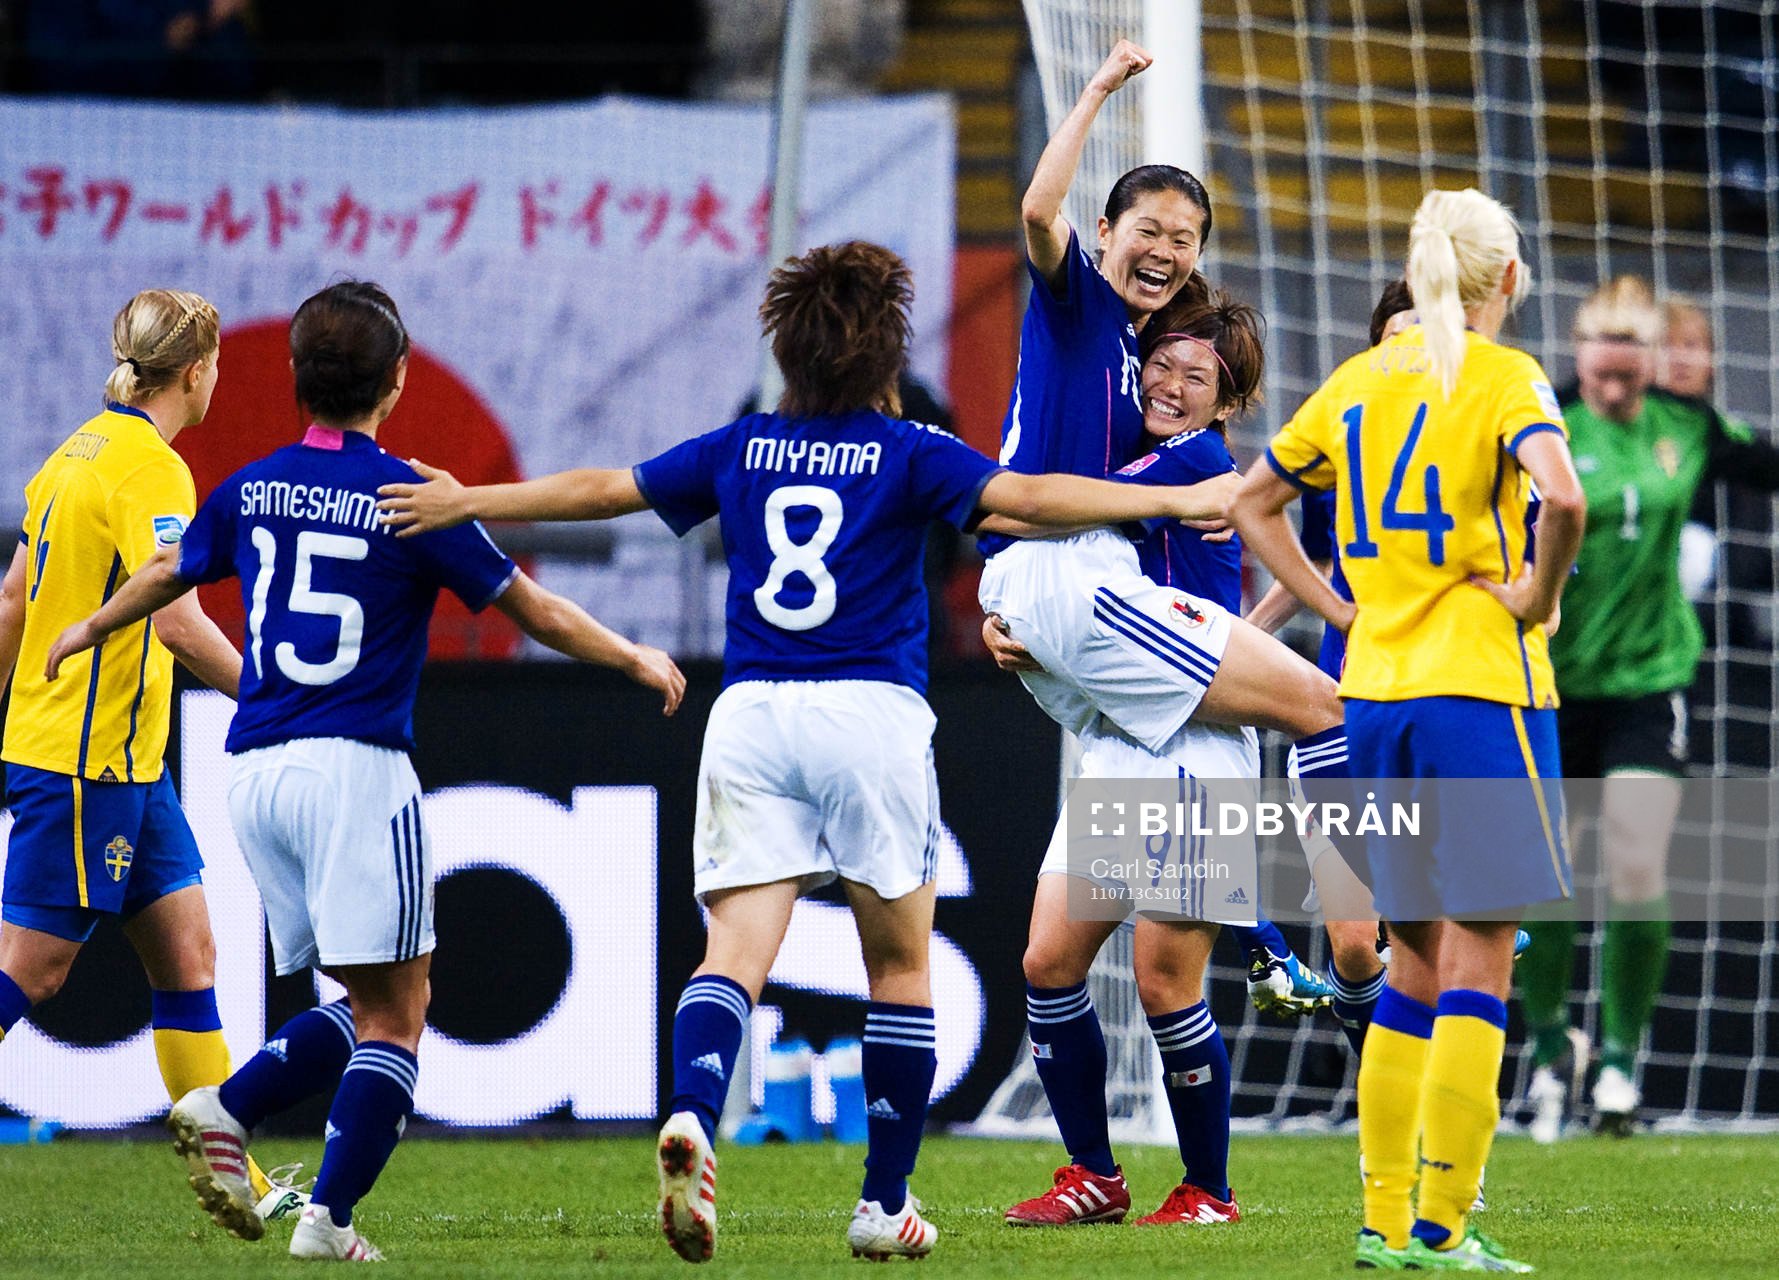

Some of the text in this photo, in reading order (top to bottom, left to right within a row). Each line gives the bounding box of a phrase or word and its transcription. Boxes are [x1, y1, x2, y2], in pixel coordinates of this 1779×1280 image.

[0, 165, 484, 255] 子ワールドカップ
[745, 437, 882, 475] MIYAMA
[1342, 402, 1454, 566] 14
[250, 526, 369, 686] 15
[753, 485, 844, 631] 8
